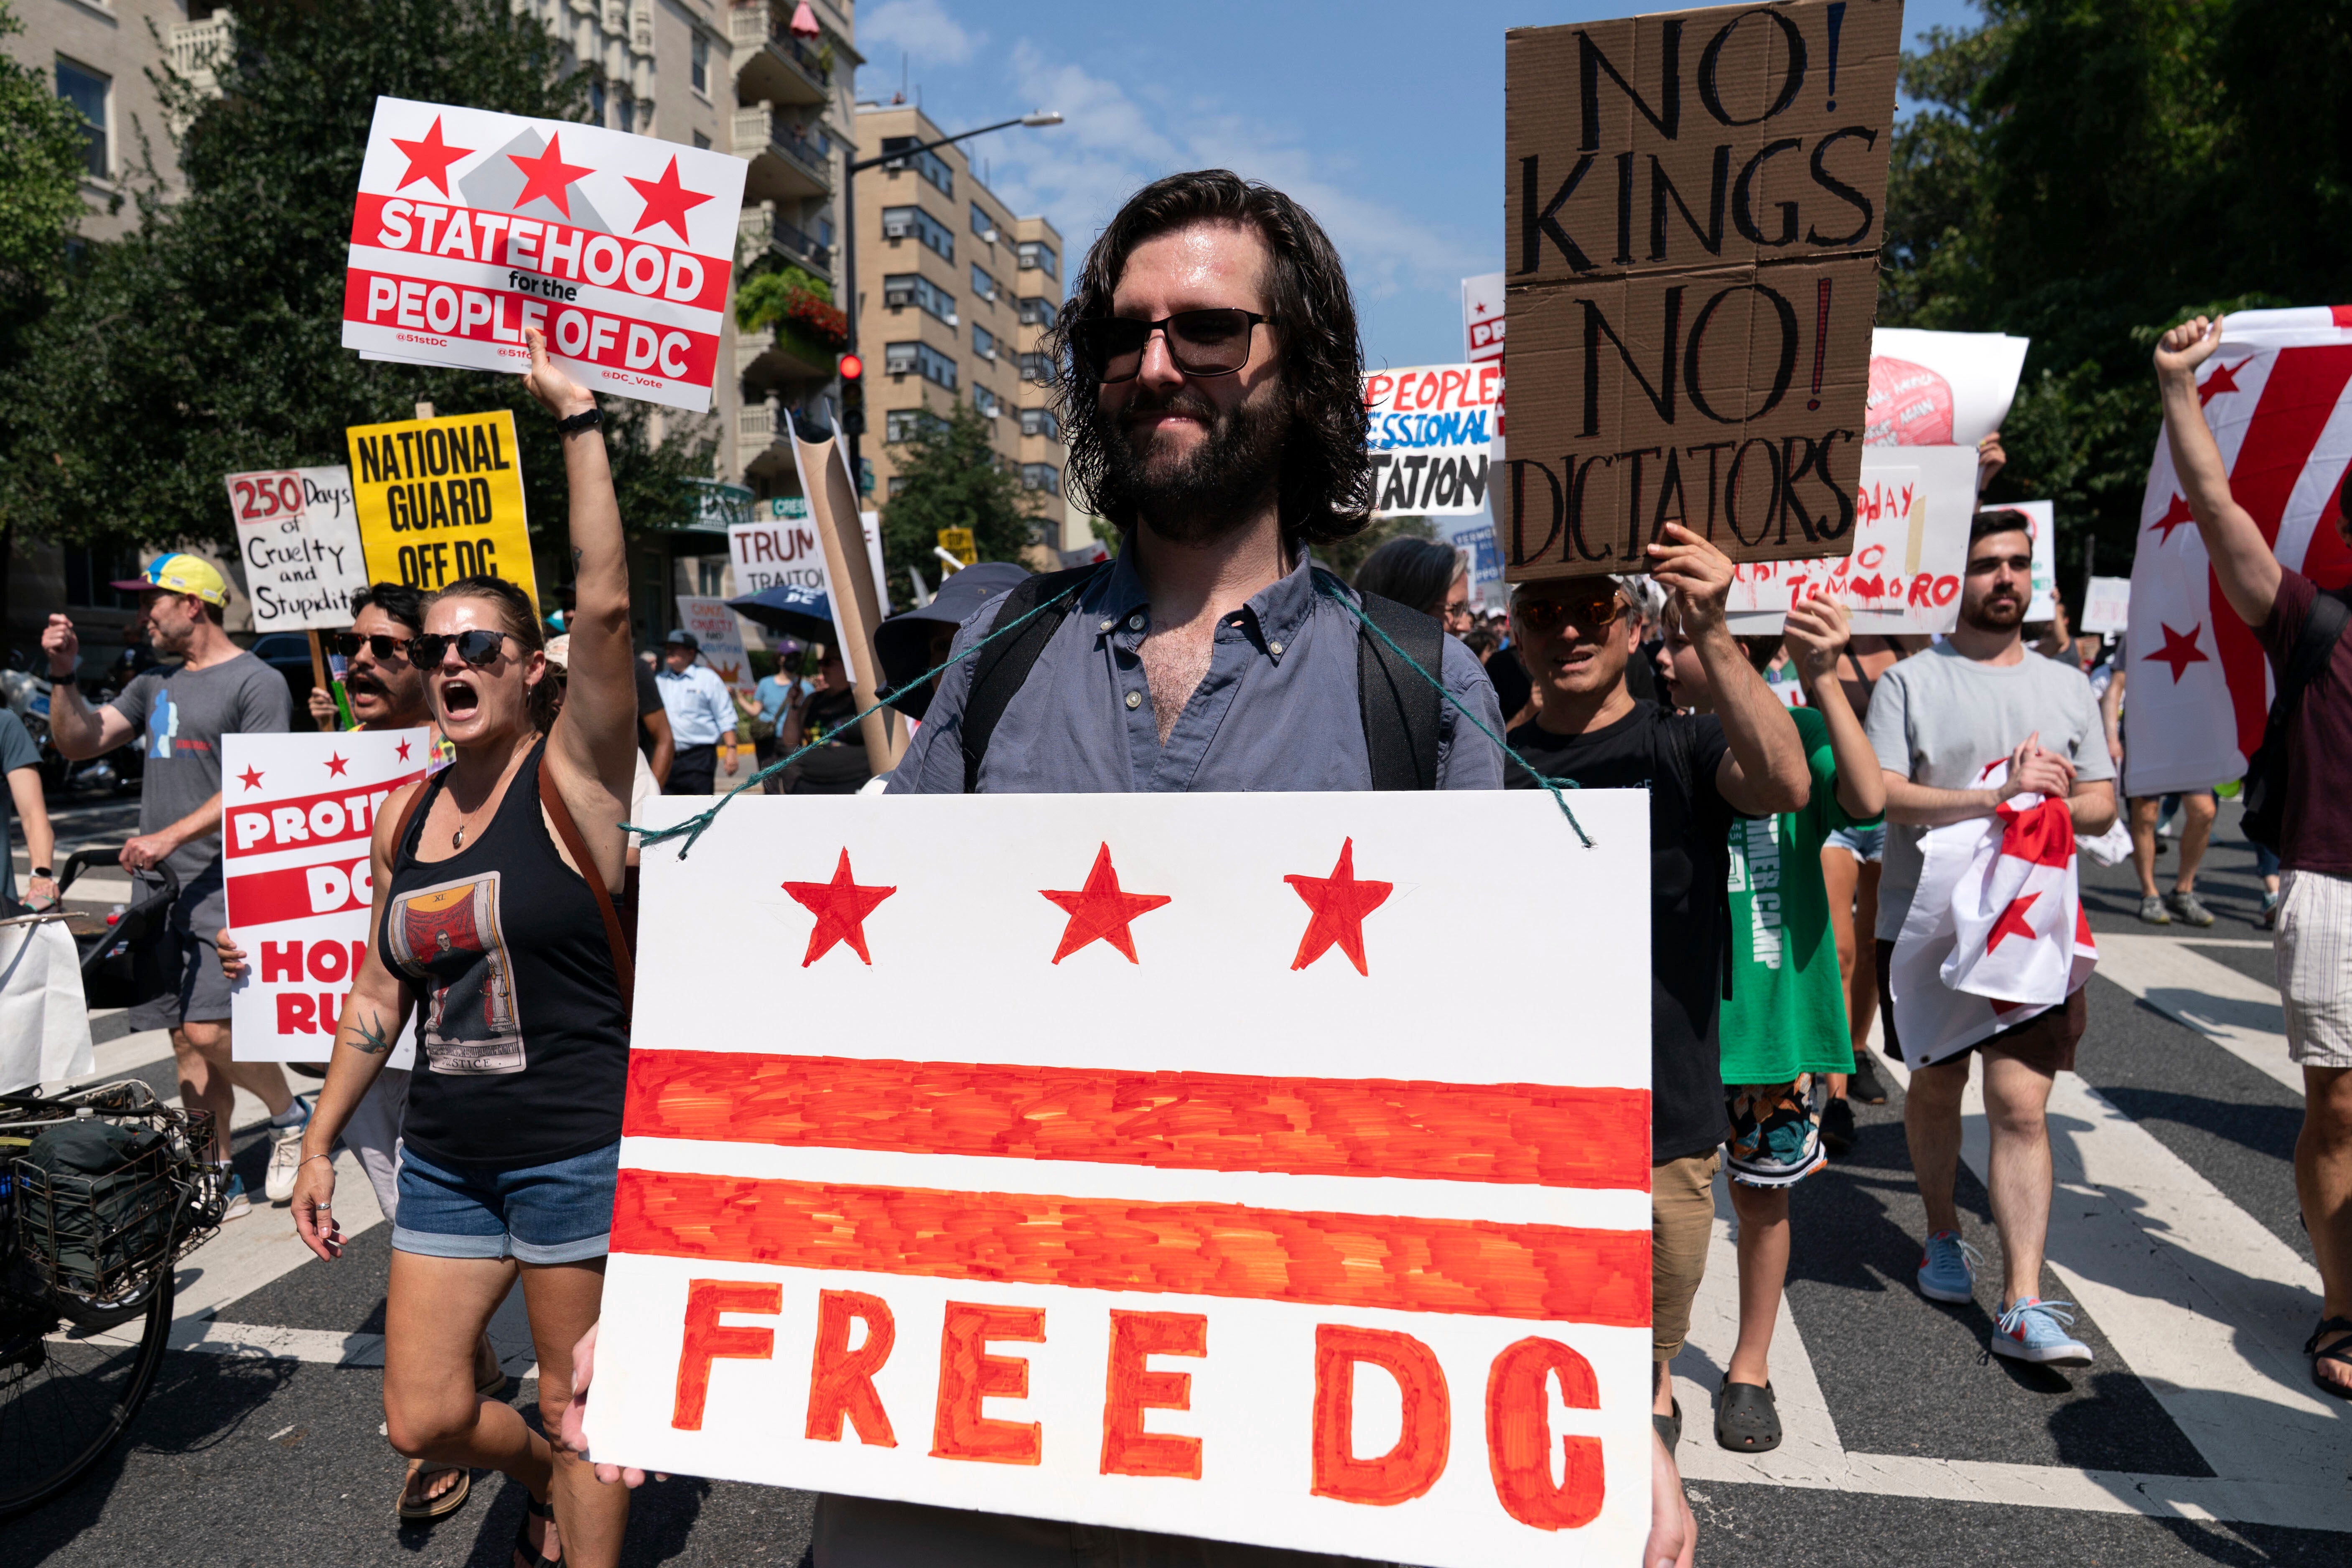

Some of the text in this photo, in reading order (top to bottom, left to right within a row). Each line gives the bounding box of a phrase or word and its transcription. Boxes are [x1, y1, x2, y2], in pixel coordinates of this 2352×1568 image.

[1573, 4, 1845, 150] NO!
[1515, 126, 1878, 275] KINGS
[377, 199, 705, 303] STATEHOOD
[509, 270, 577, 302] for the
[367, 276, 693, 379] PEOPLE OF DC
[396, 333, 448, 347] @51stDC
[601, 370, 663, 389] @DC_Vote
[1574, 277, 1832, 438] NO!
[1364, 367, 1499, 411] PEOPLE
[357, 423, 510, 484] NATIONAL
[234, 477, 351, 520] 250 Days
[281, 515, 300, 533] of
[387, 477, 492, 532] GUARD
[1507, 429, 1855, 567] DICTATORS
[247, 537, 344, 575] Cruelty
[280, 565, 317, 583] and
[398, 538, 498, 588] OFF DC
[234, 779, 421, 850] PROT
[433, 893, 447, 903] XI
[1751, 892, 1782, 970] CAMP
[442, 1056, 491, 1069] JUSTICE
[672, 1278, 1607, 1532] FREE DC
